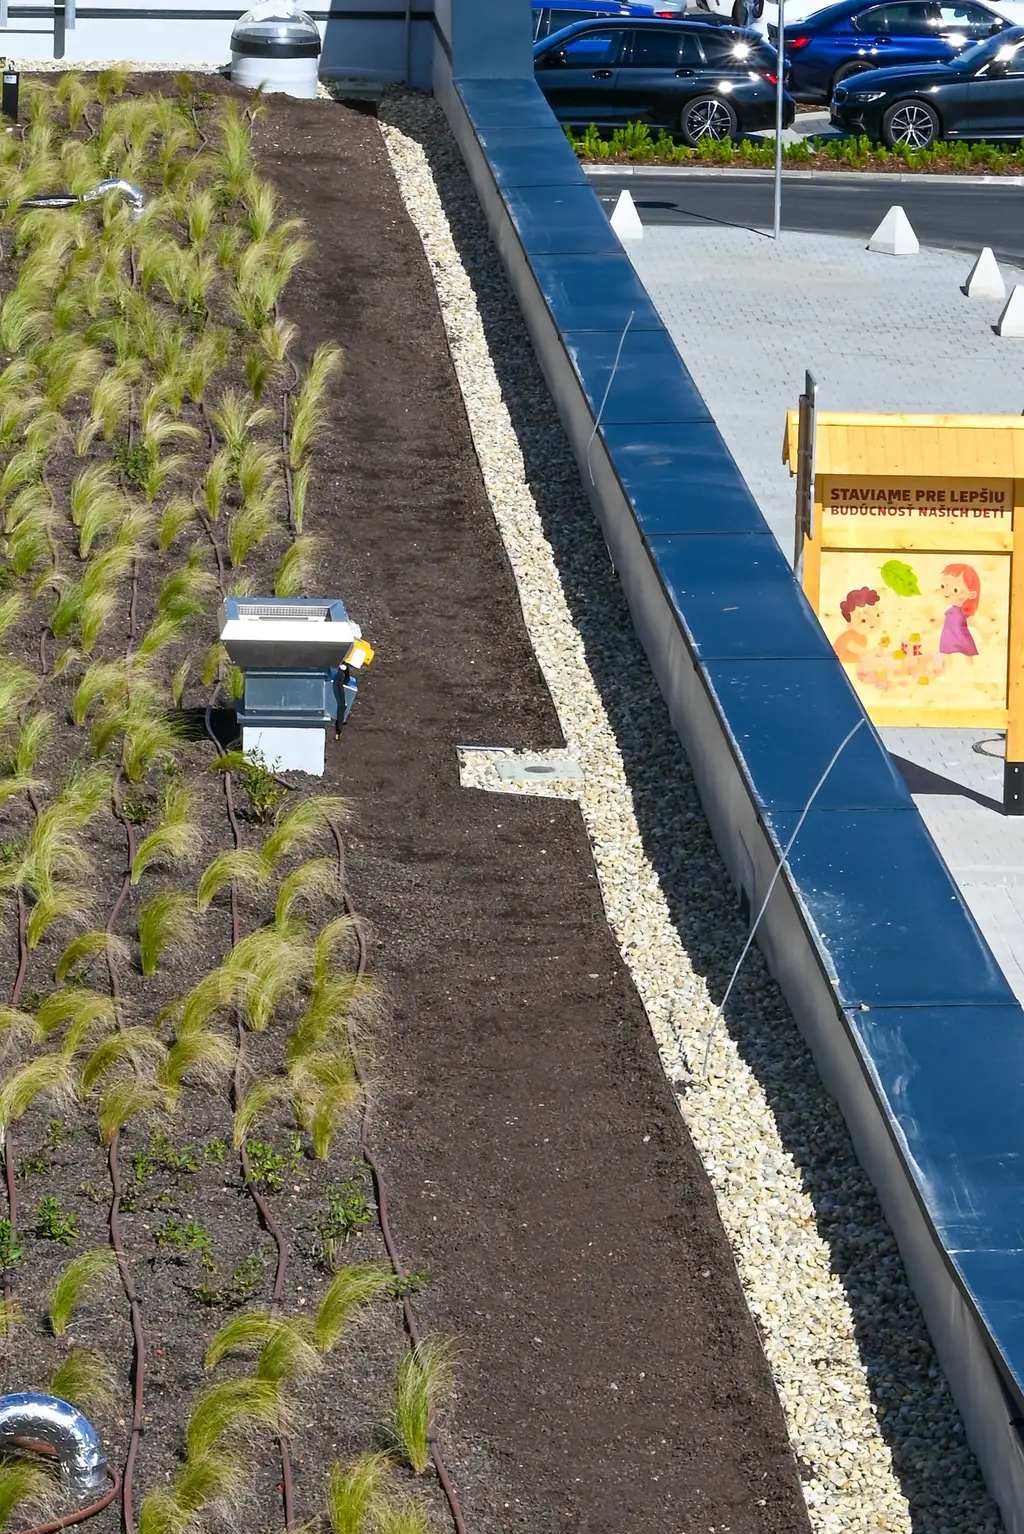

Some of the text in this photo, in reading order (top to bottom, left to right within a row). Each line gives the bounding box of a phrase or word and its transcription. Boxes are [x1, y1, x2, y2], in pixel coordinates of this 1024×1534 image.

[830, 487, 1005, 504] STAVIAME PRE LEPŠIU
[830, 503, 1005, 519] BUDÚCNOSŤ NAŠICH DETÍ
